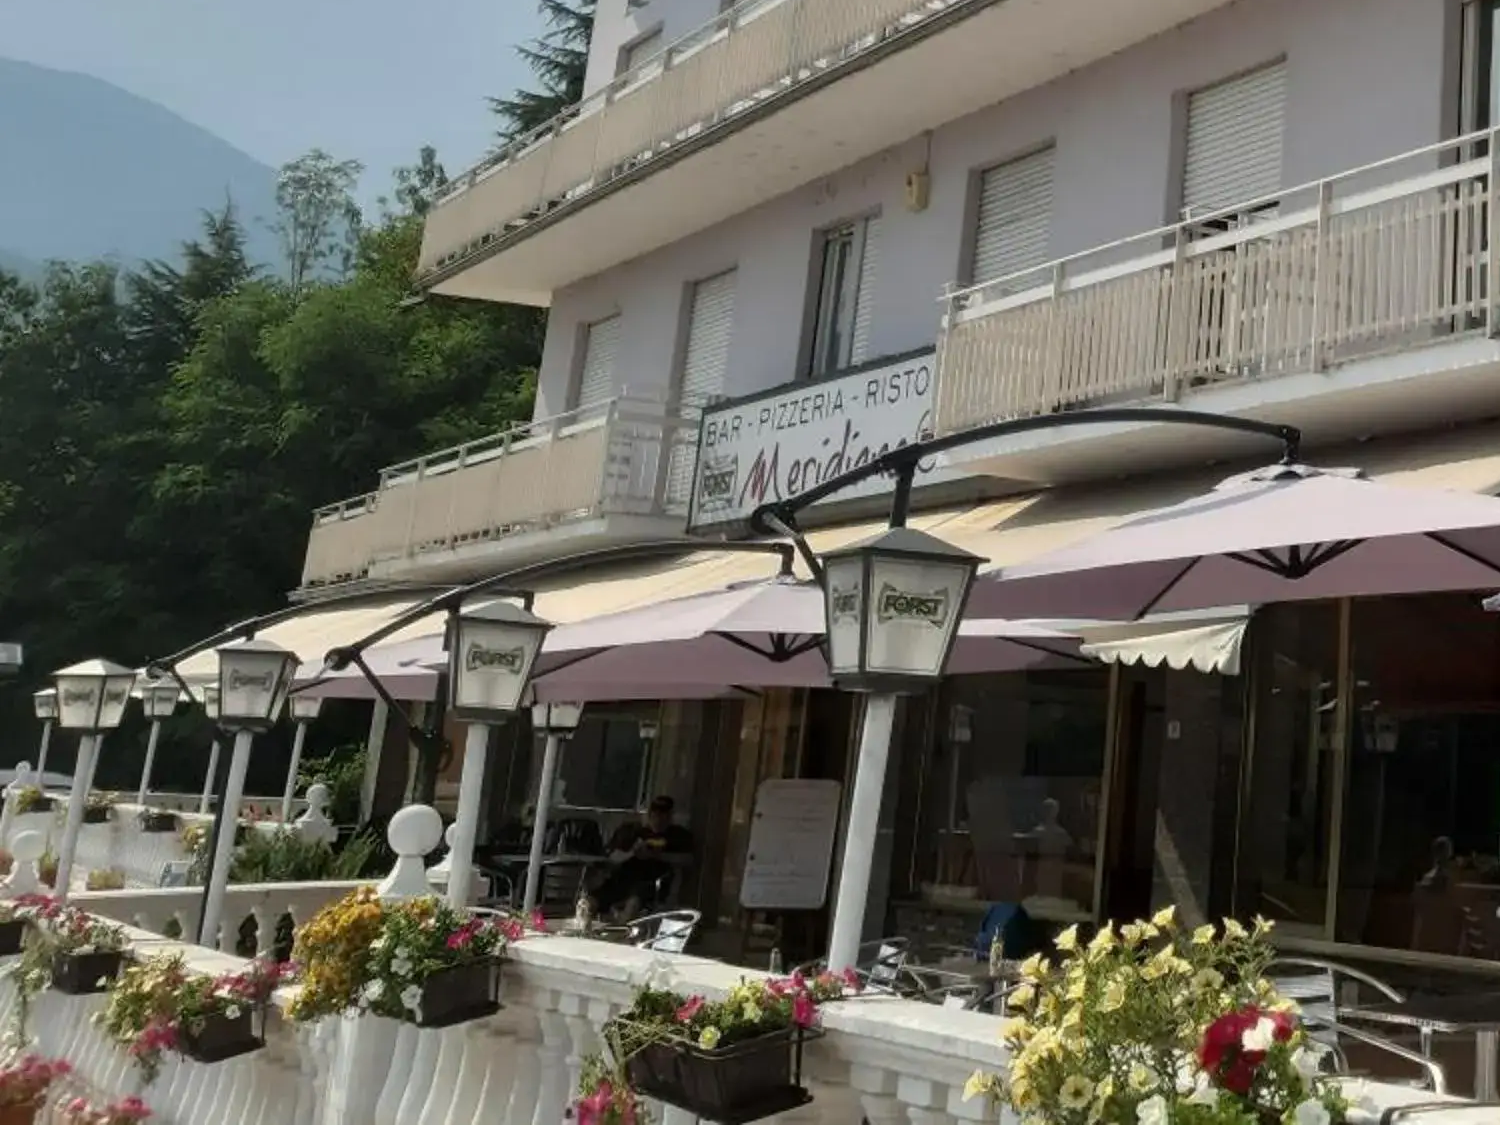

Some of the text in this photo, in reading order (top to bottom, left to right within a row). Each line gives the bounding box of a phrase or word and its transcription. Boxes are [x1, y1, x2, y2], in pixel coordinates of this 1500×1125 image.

[704, 415, 742, 448] BAR
[759, 388, 845, 431] PIZZERIA
[884, 594, 943, 616] FORST
